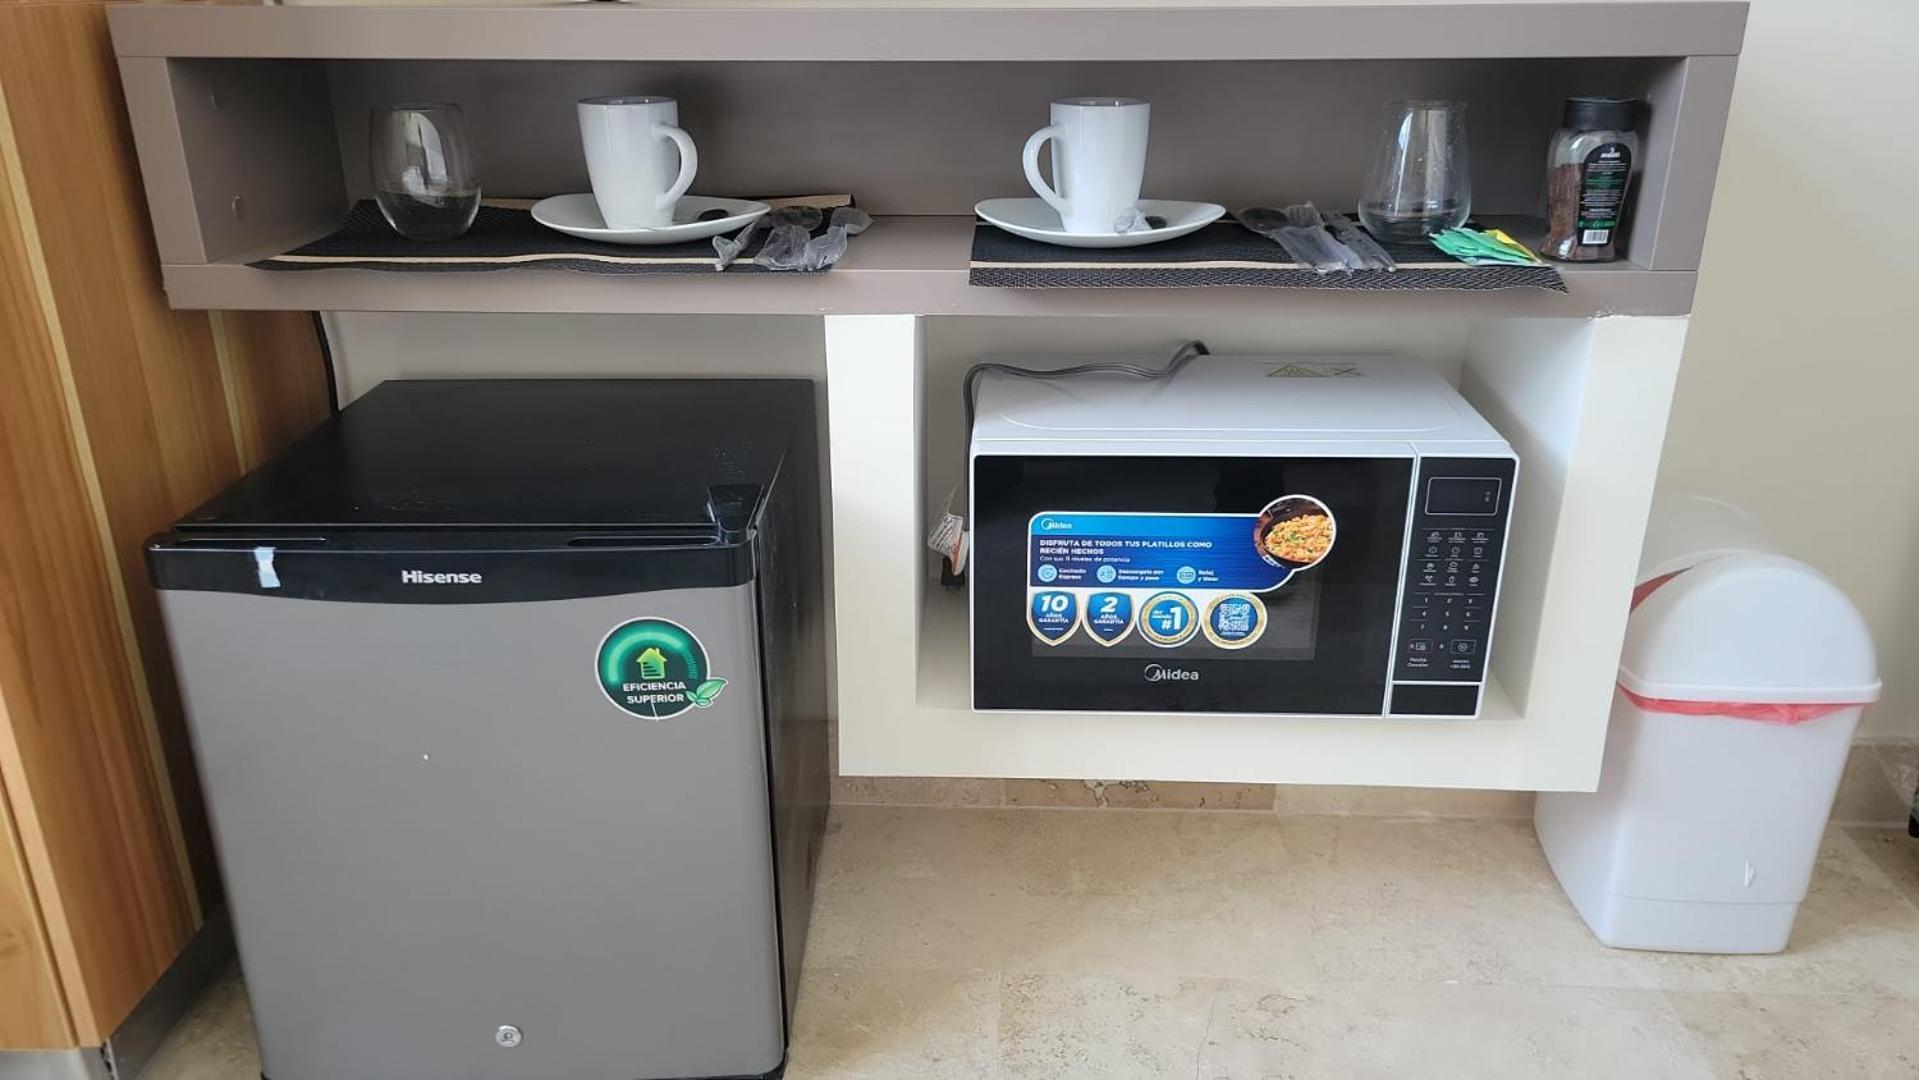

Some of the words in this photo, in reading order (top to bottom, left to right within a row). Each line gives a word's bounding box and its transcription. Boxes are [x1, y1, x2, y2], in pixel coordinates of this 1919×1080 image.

[1041, 518, 1072, 531] Midea
[1040, 539, 1080, 547] DISFRUTA
[1095, 540, 1123, 548] TODOS
[1187, 541, 1212, 549] COMO
[1040, 546, 1069, 554] RECIÉN
[401, 569, 482, 584] Hisense
[1041, 595, 1069, 612] 10
[1100, 596, 1118, 613] 2
[1144, 663, 1199, 682] Midea
[622, 681, 687, 693] EFICIENCIA
[627, 693, 685, 705] SUPERIOR
